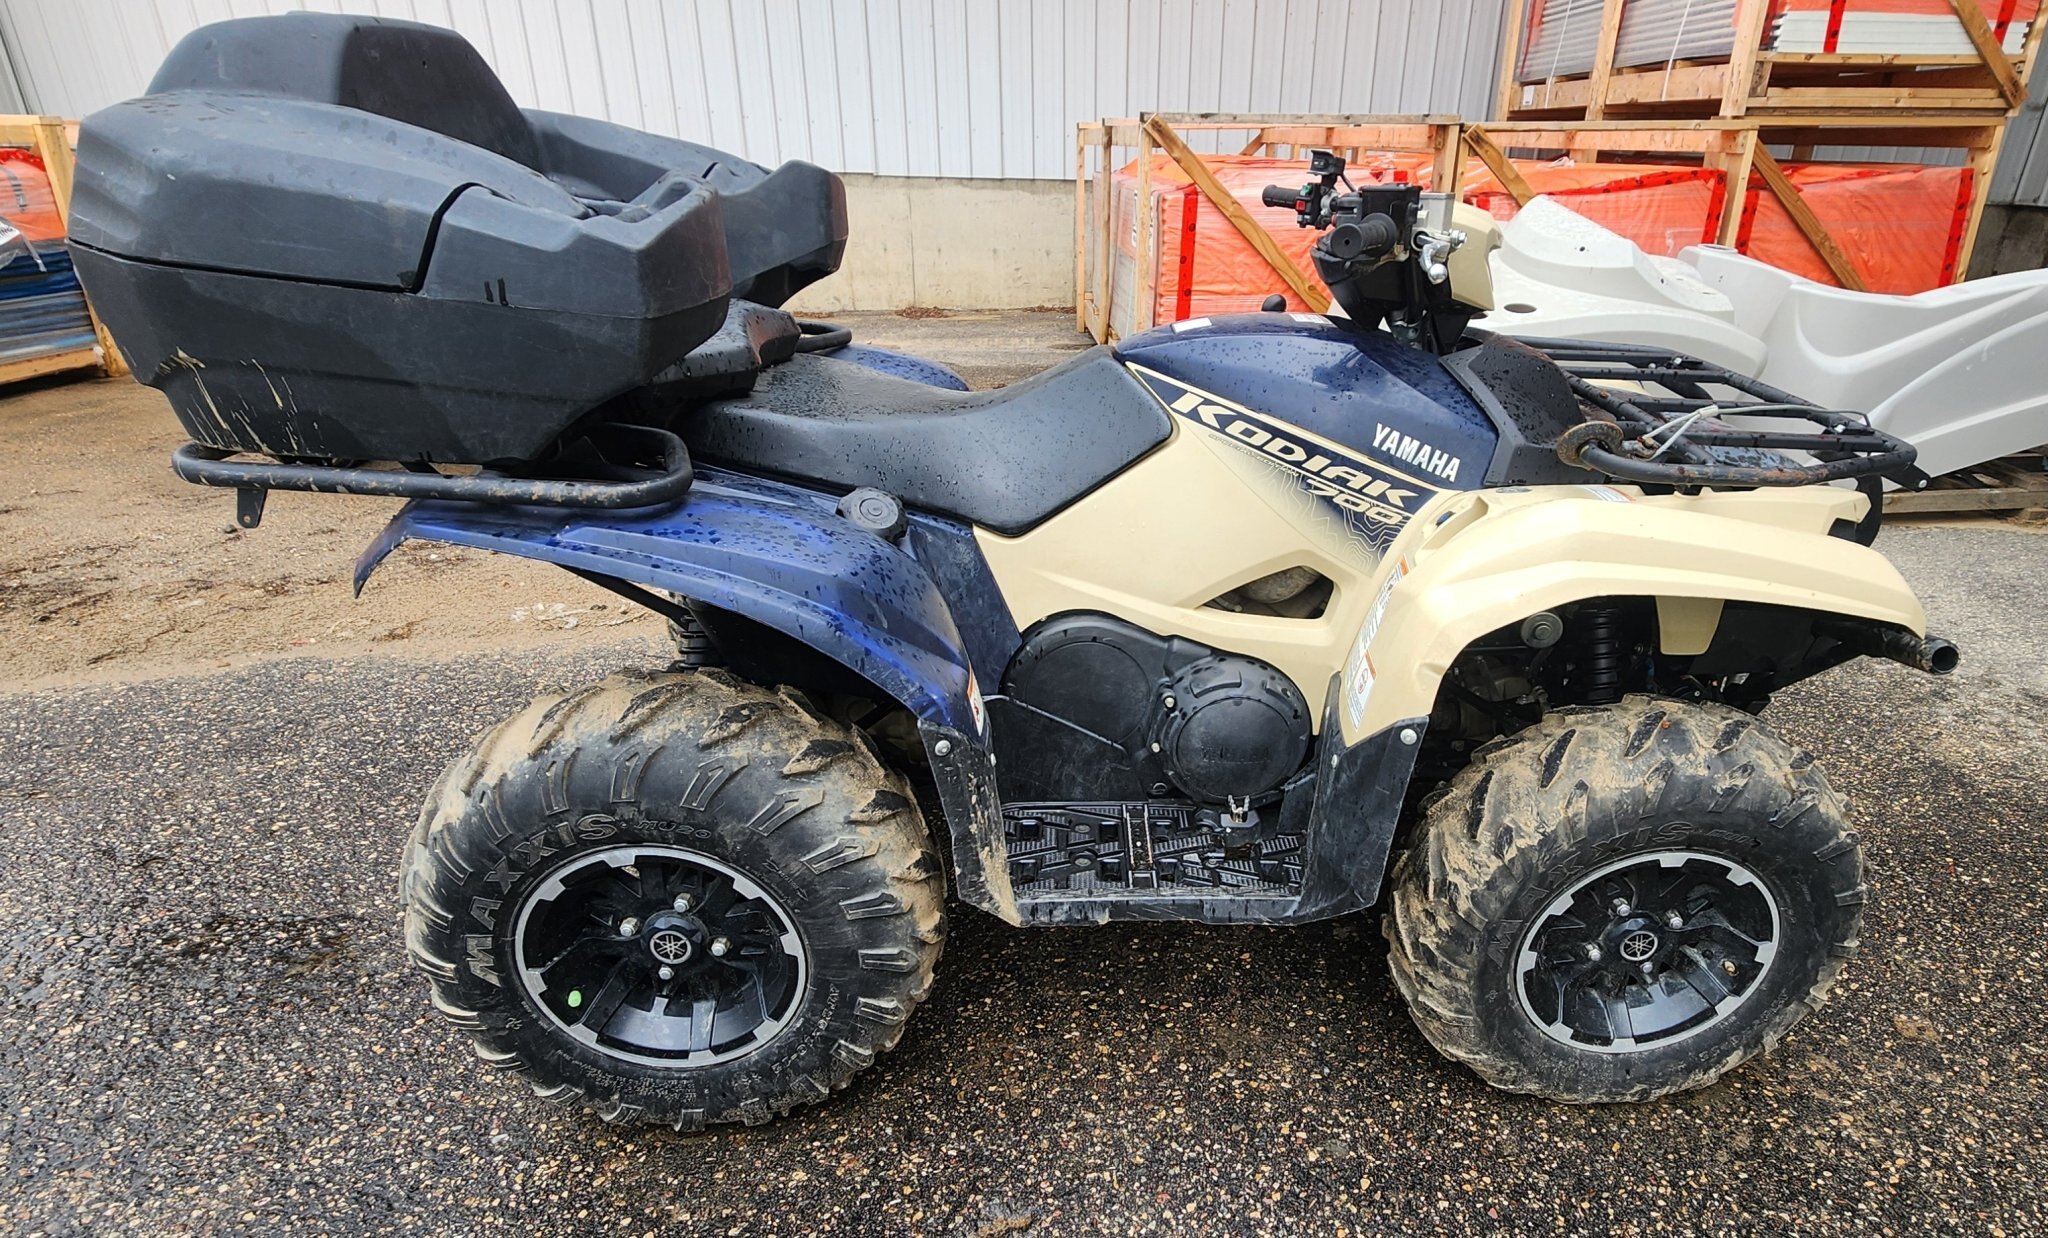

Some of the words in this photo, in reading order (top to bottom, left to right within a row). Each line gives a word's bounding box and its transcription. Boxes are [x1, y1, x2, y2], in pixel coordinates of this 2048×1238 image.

[1170, 391, 1419, 507] KODIAK
[1372, 422, 1461, 482] YAMAHA
[1305, 478, 1404, 525] 700
[460, 813, 618, 988] MAXXIS
